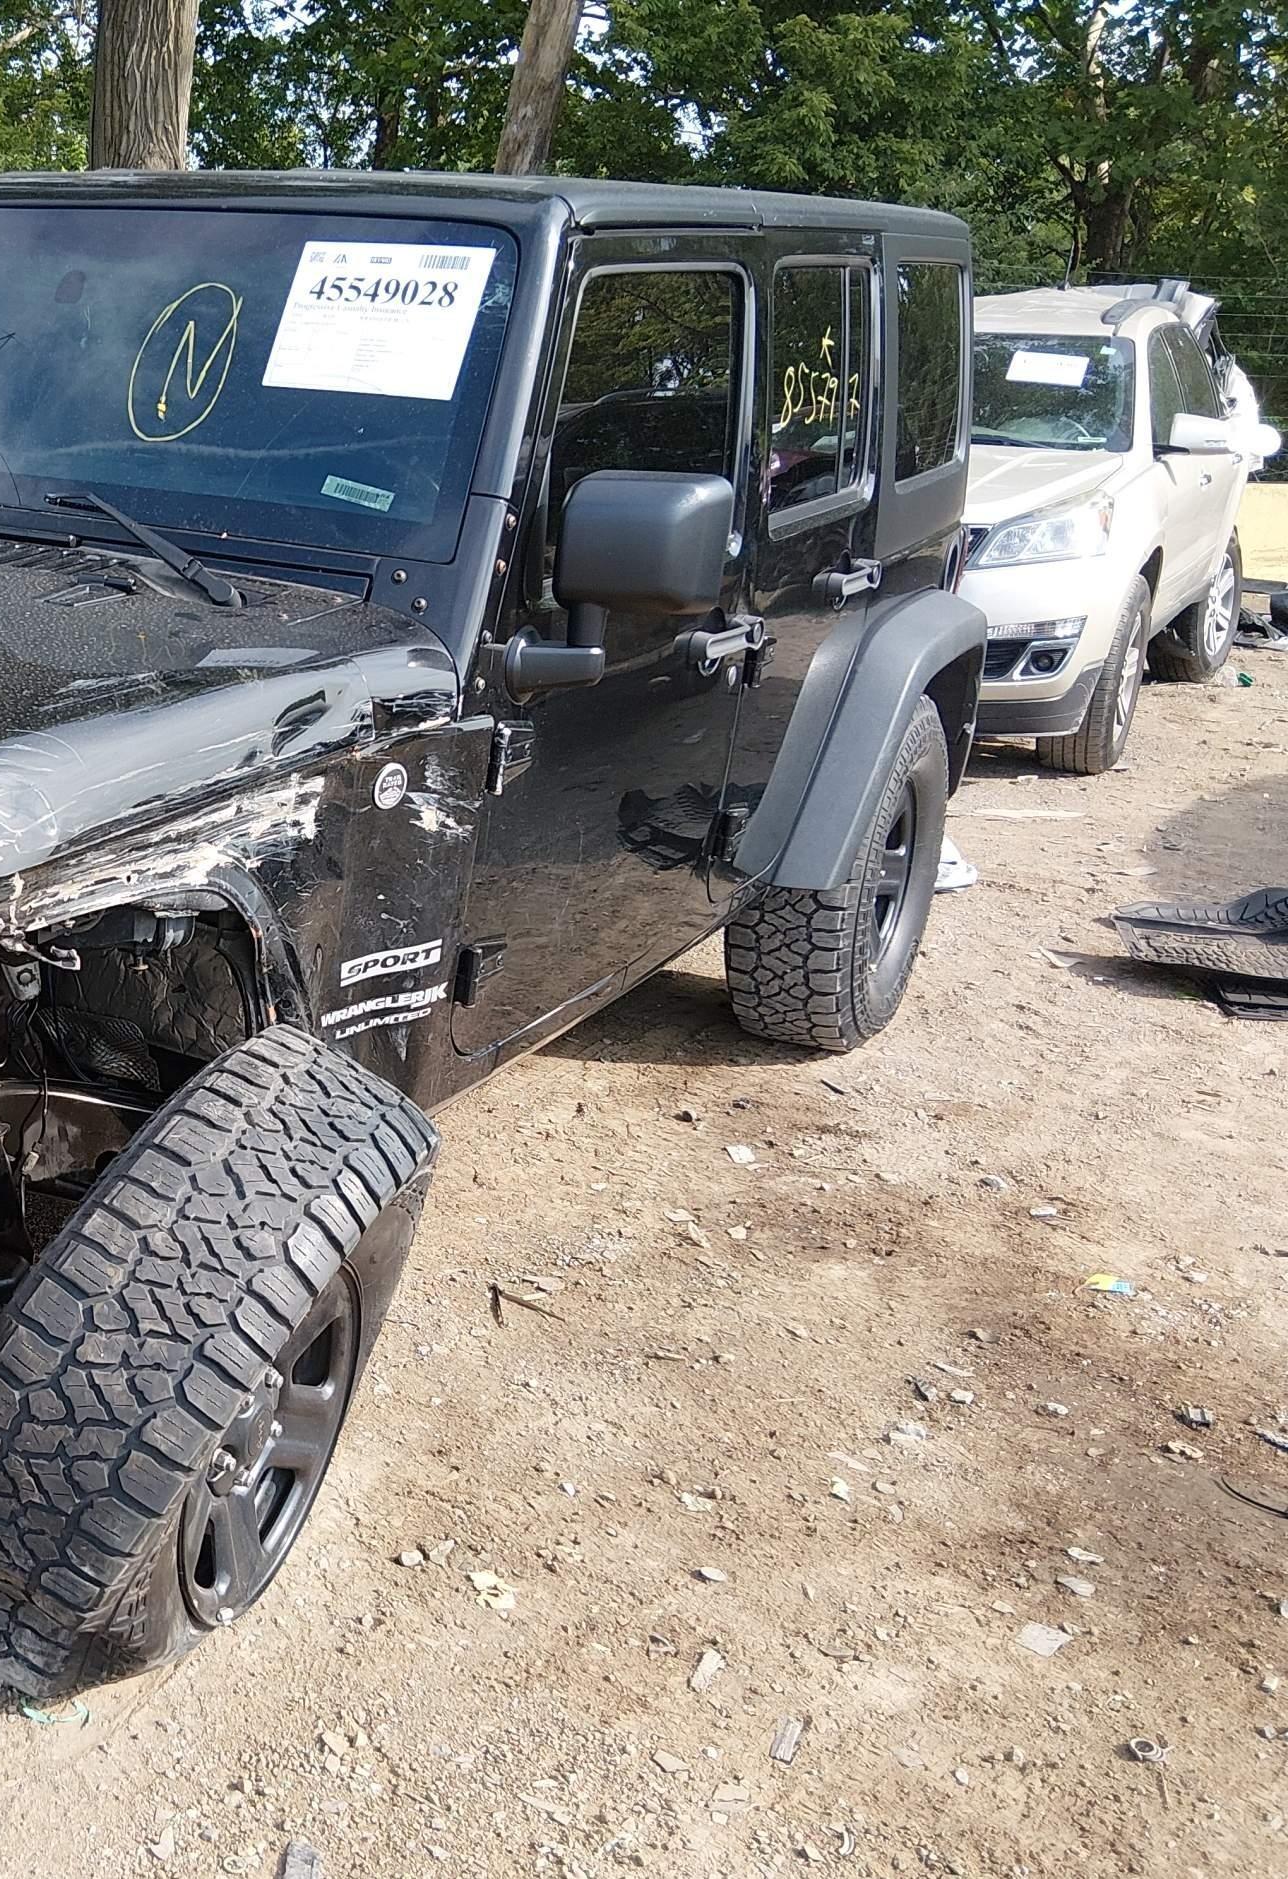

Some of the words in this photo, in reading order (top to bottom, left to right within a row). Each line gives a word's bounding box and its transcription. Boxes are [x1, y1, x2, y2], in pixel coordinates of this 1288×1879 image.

[309, 275, 459, 308] 45549028
[346, 949, 433, 976] SPORT
[335, 1007, 431, 1039] UNLIMITED
